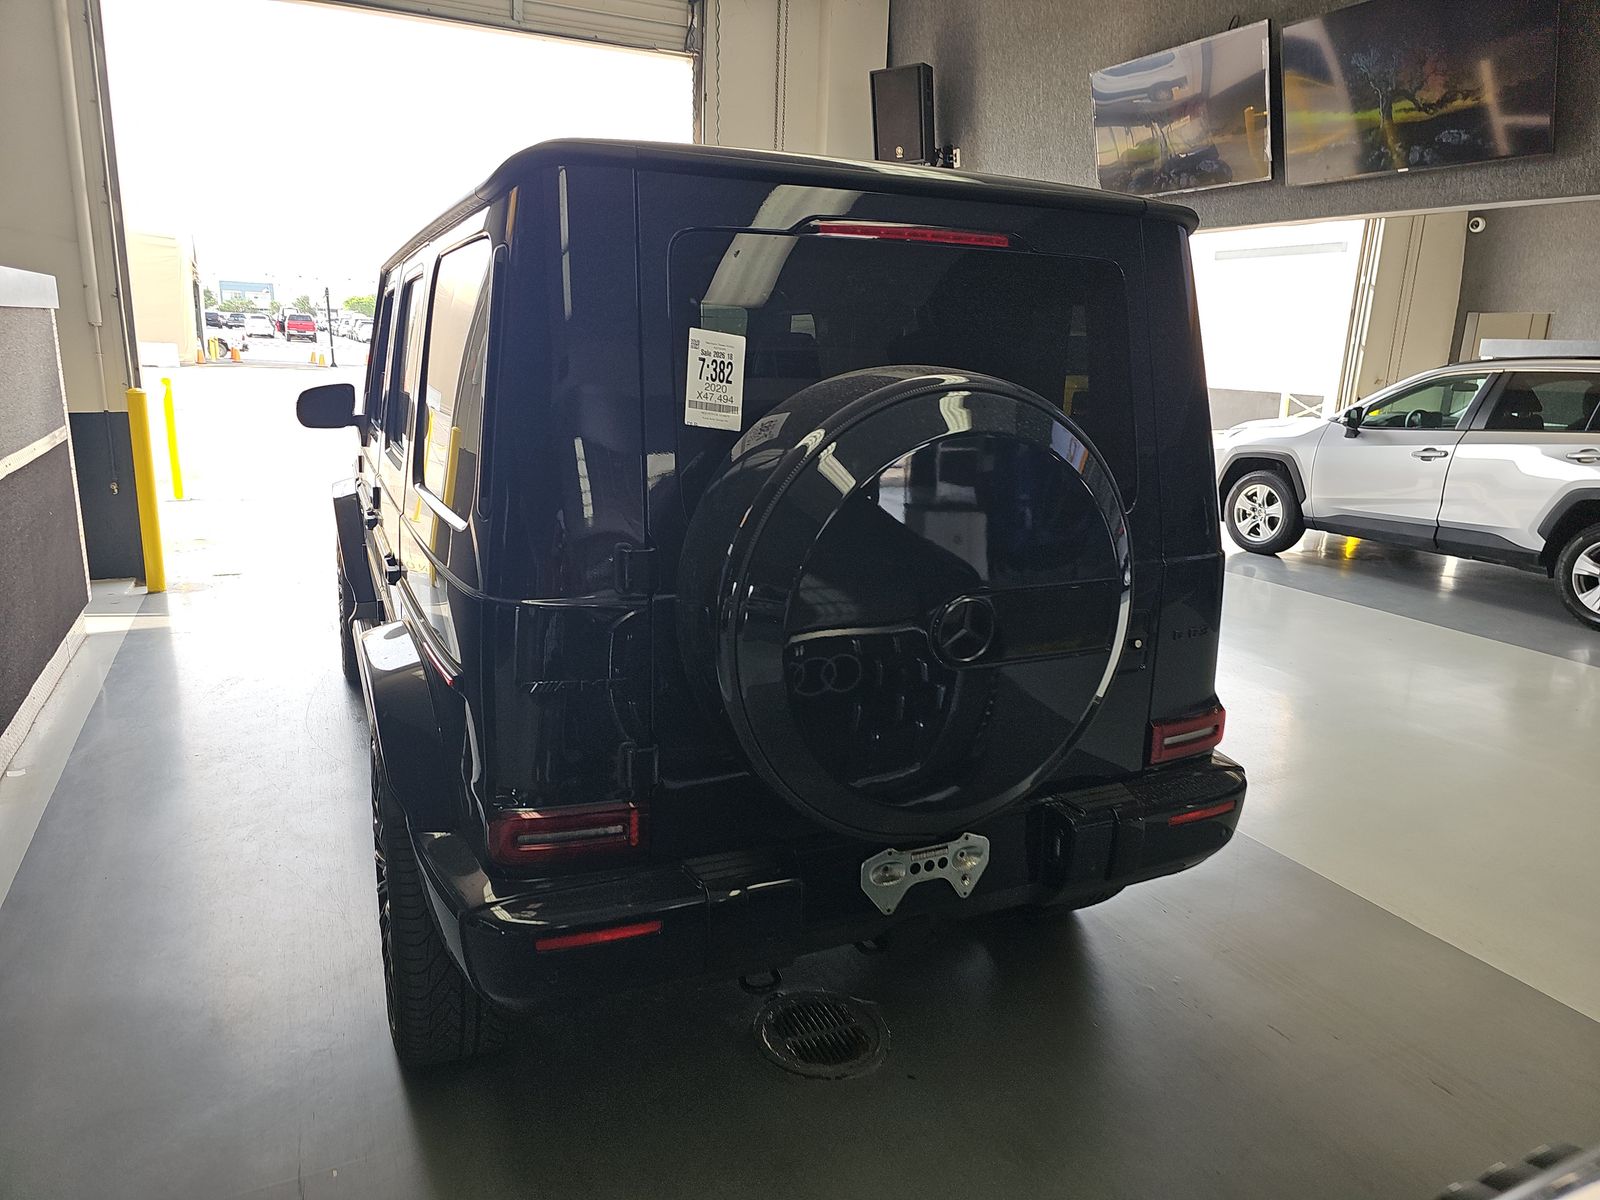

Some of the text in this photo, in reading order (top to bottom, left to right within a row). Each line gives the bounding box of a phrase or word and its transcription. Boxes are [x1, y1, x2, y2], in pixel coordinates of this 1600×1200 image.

[700, 348, 712, 358] Sale
[698, 357, 734, 385] 7:382
[704, 383, 728, 394] 2020
